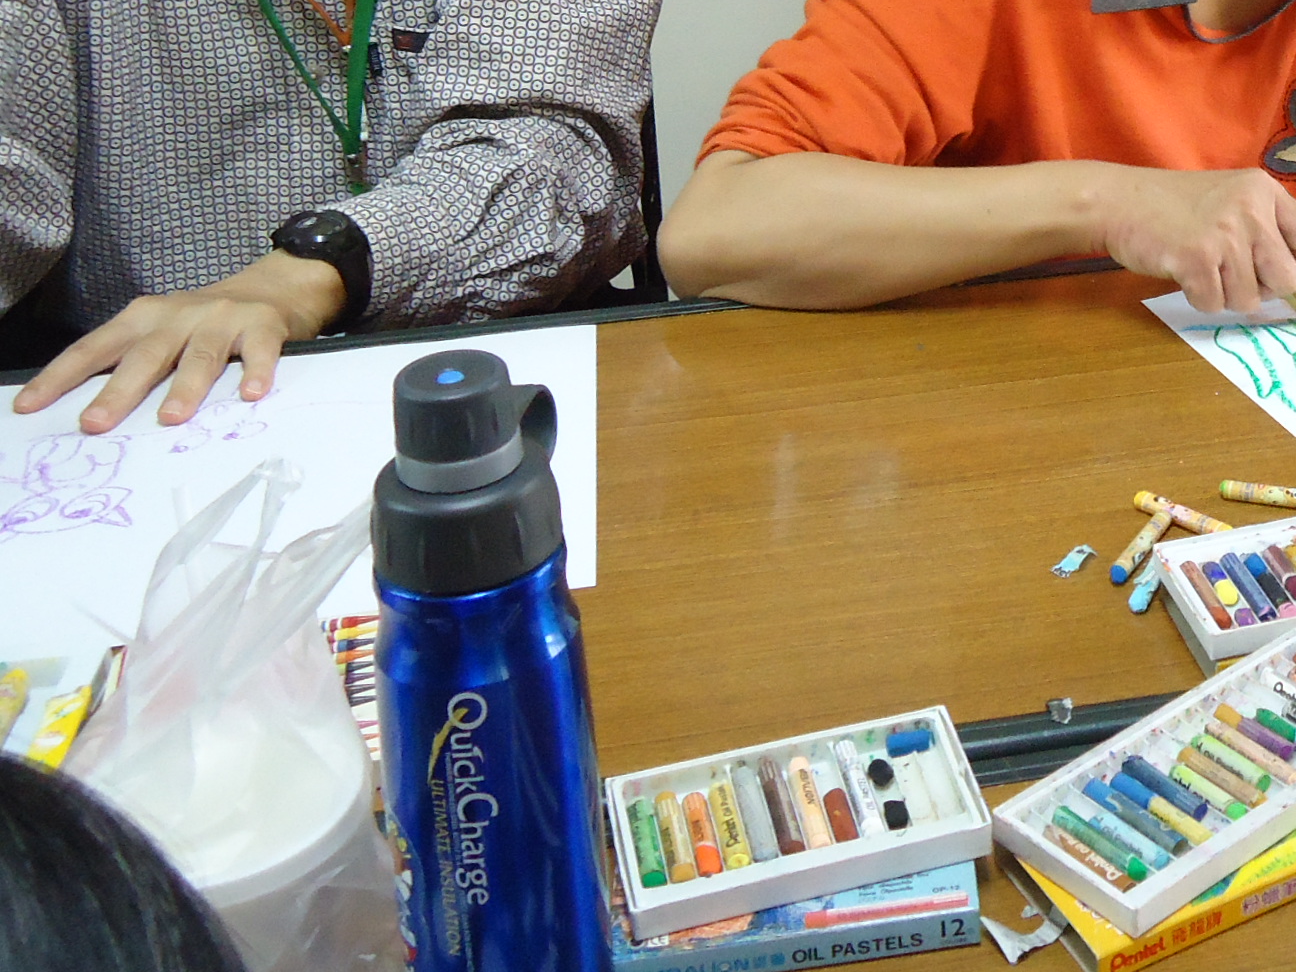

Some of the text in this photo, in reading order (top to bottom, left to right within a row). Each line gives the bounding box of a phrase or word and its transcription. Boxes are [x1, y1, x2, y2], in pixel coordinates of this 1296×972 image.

[446, 691, 500, 906] QuickCharge
[430, 778, 462, 958] ULTIMATE INSULATION
[791, 941, 825, 965] OIL
[830, 932, 924, 959] PASTELS
[939, 917, 966, 940] 12
[1111, 936, 1167, 972] Pentel
